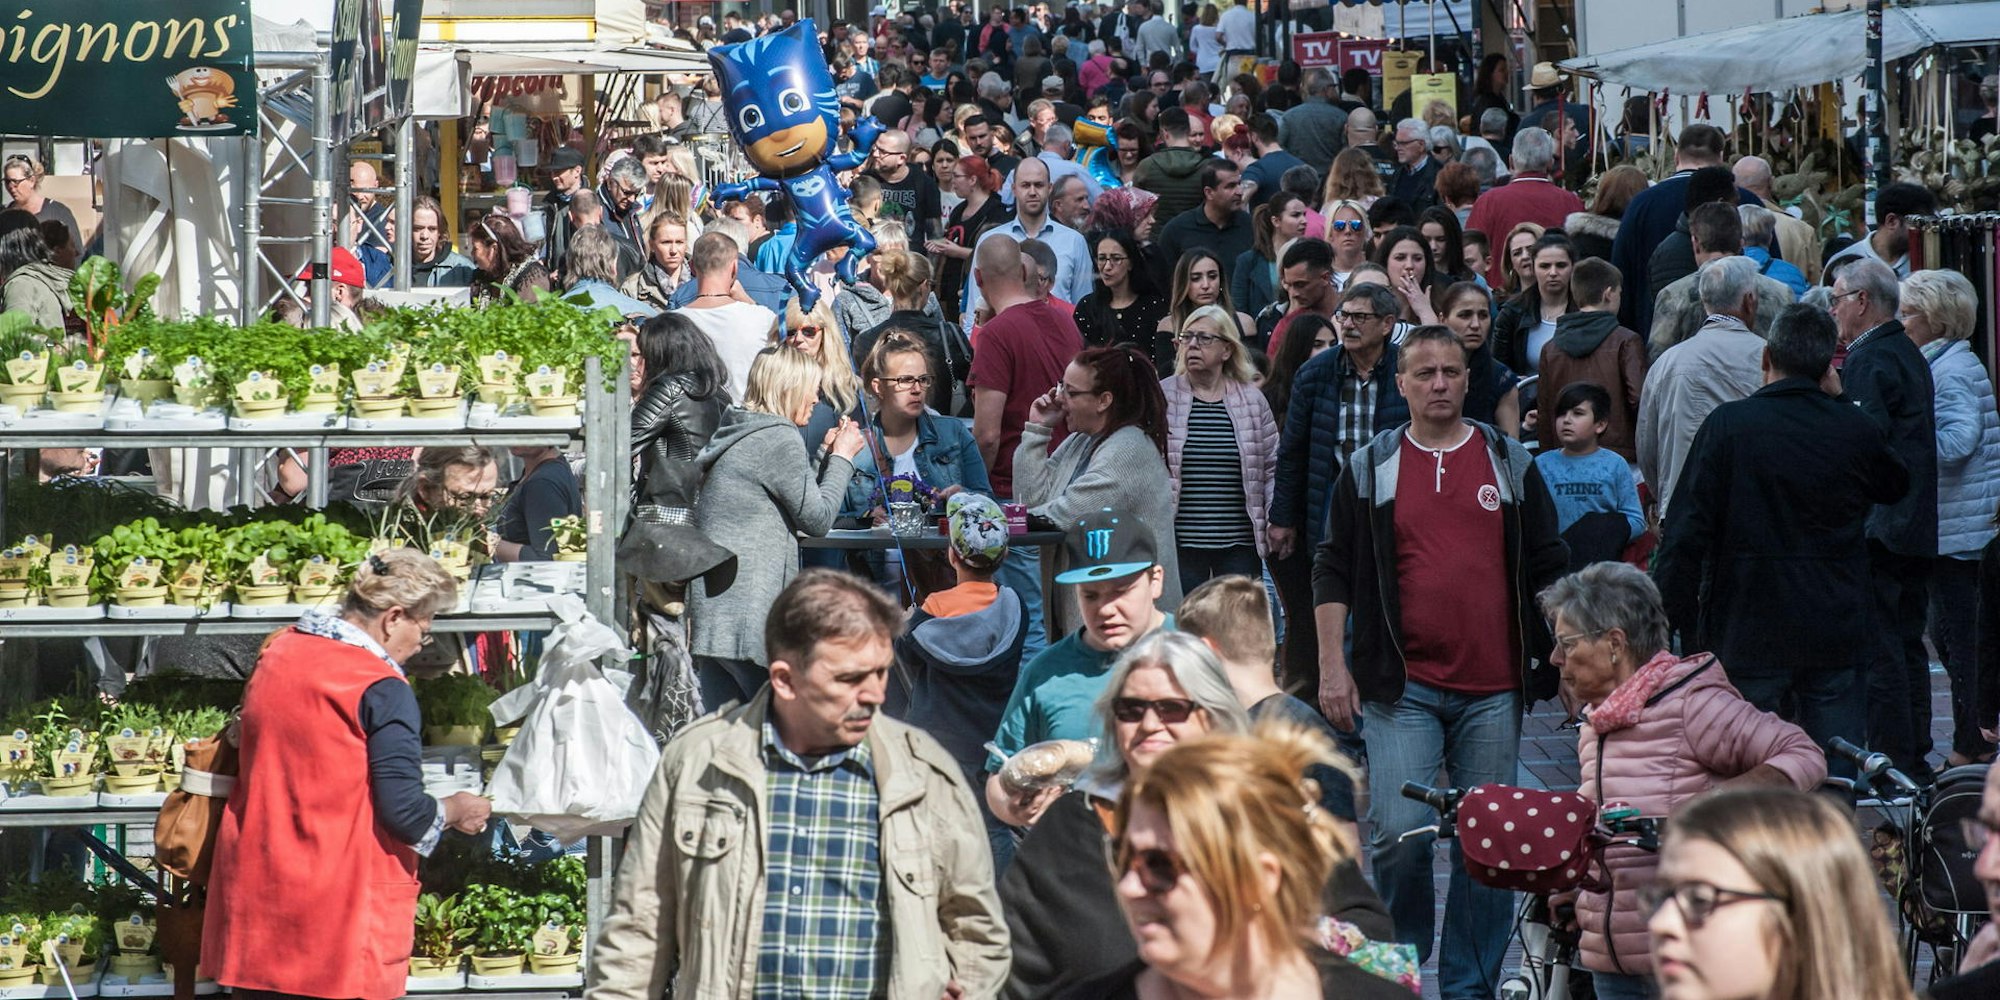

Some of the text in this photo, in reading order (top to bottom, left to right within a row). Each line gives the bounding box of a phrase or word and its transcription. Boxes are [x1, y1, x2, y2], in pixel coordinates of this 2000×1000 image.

[0, 9, 237, 99] ignons
[1302, 41, 1331, 57] TV
[1349, 49, 1380, 66] TV
[1554, 482, 1604, 496] THINK
